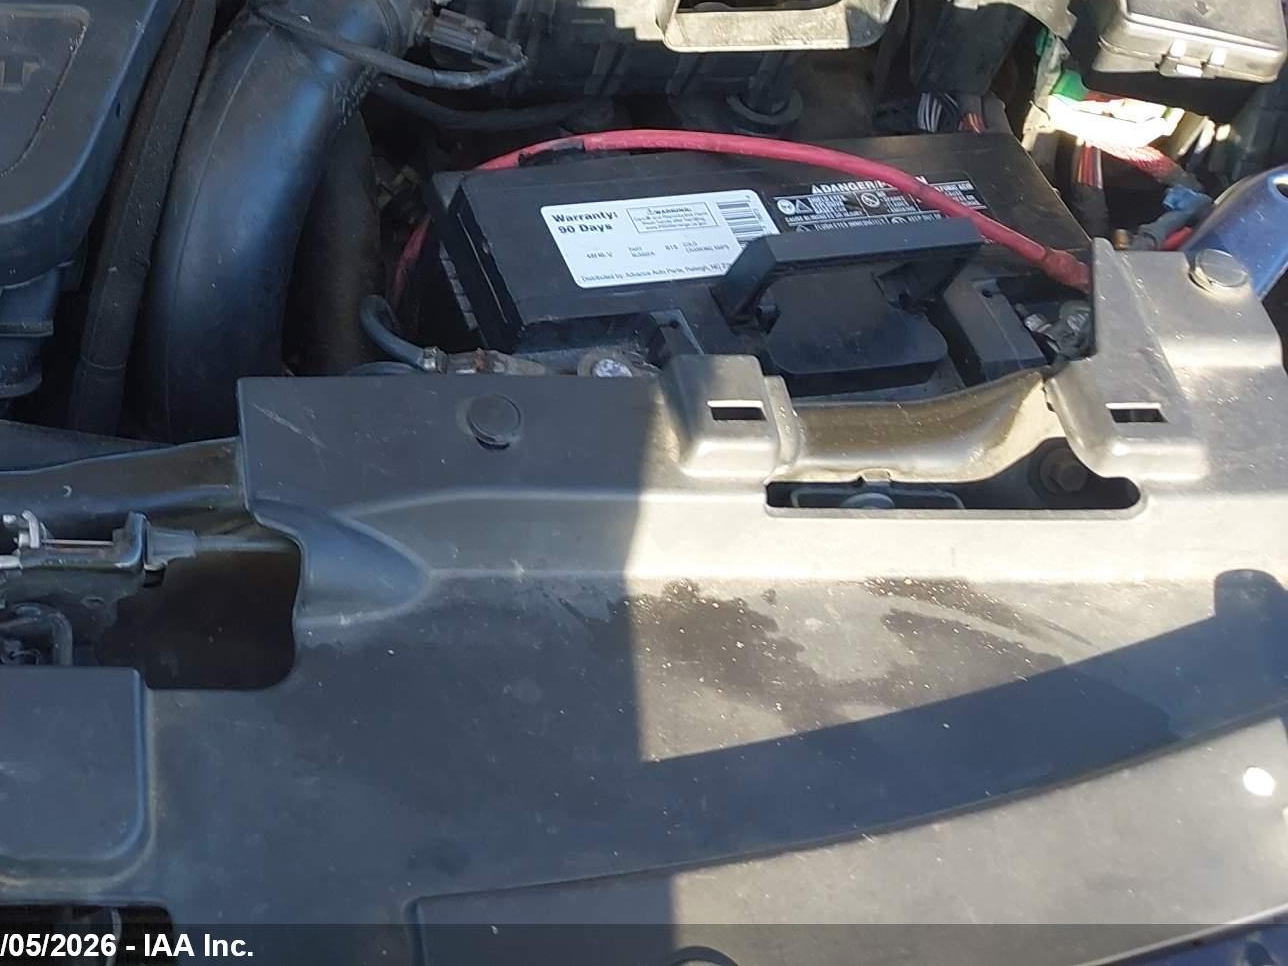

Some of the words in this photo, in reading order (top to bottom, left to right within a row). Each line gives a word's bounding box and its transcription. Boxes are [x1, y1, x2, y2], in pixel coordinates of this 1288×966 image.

[552, 211, 618, 223] Warranty:
[558, 225, 576, 234] 90
[580, 223, 614, 234] Days
